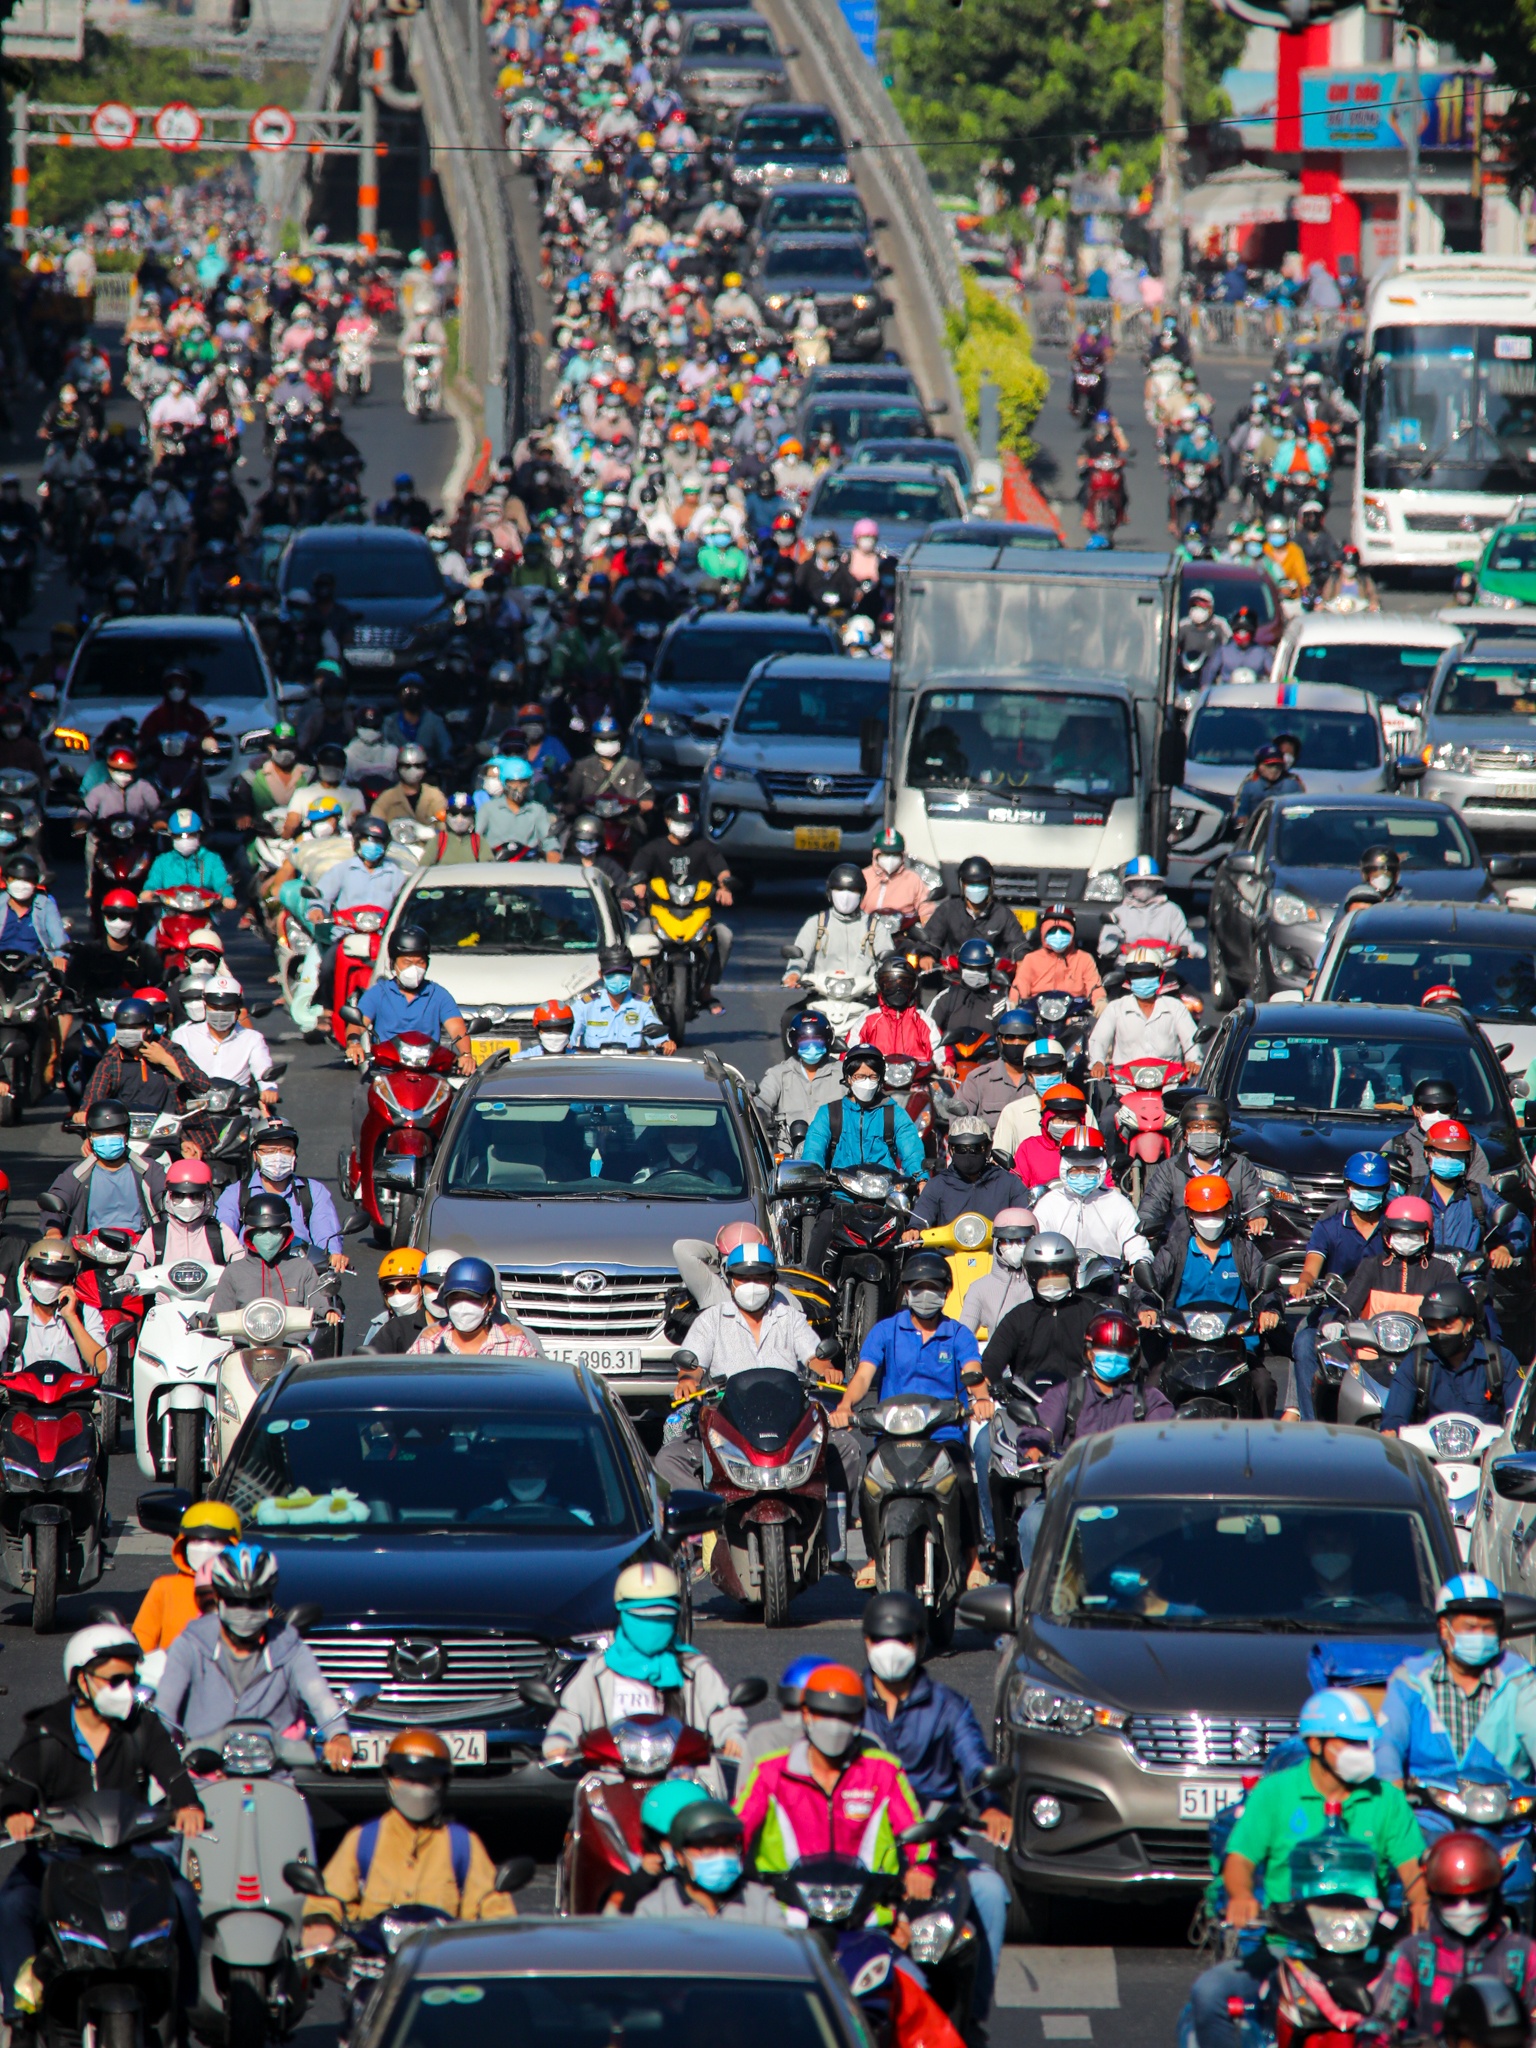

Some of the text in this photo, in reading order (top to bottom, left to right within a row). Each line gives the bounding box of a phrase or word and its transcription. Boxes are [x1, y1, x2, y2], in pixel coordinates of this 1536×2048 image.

[988, 808, 1046, 824] ISUZU
[544, 1350, 634, 1370] 1F-396.31
[1184, 1788, 1245, 1814] 51H-
